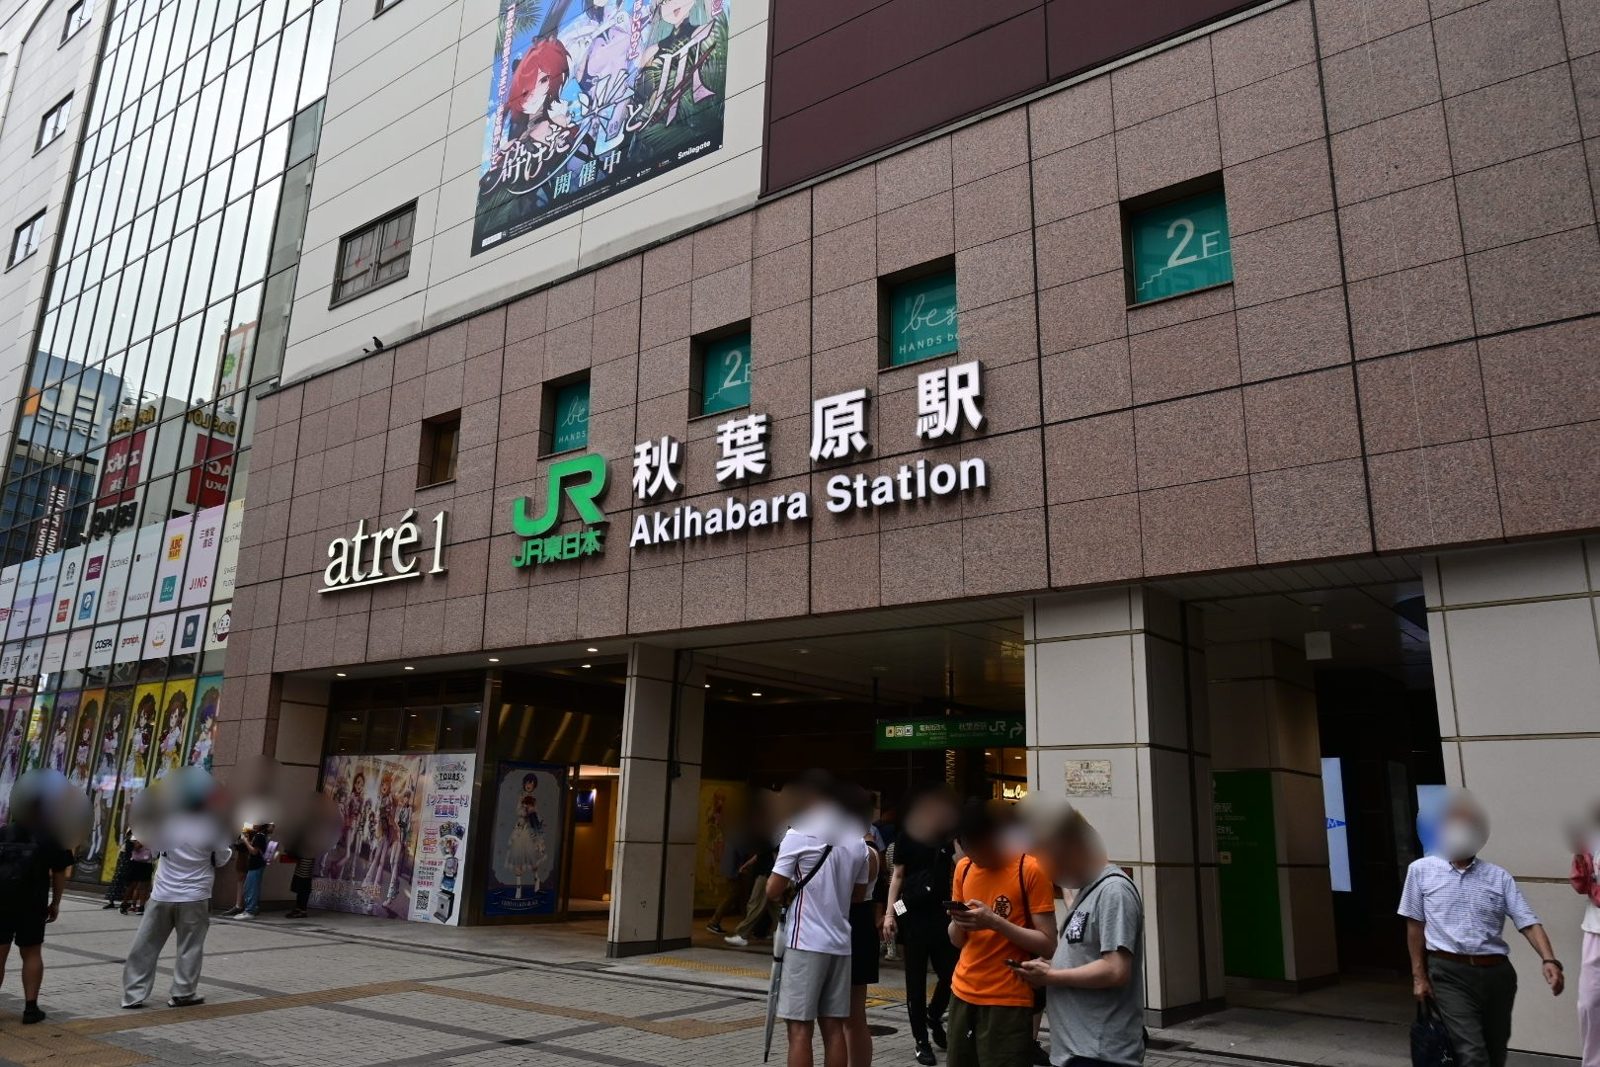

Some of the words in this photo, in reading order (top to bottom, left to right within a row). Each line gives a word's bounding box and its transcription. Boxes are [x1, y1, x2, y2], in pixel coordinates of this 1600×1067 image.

[677, 140, 711, 160] Smilegate
[553, 149, 622, 200] 開催中
[1166, 218, 1221, 268] 2F
[899, 335, 942, 354] HANDS
[558, 431, 587, 443] HANDS
[633, 360, 984, 500] 秋葉原駅
[512, 452, 607, 537] JR
[630, 490, 808, 548] Akihabara
[826, 456, 986, 513] Station
[323, 508, 418, 588] atré
[429, 510, 448, 575] 1
[511, 527, 603, 567] JR東日本
[95, 639, 112, 650] COSPA
[989, 721, 1006, 732] JR
[440, 773, 460, 781] TOURS
